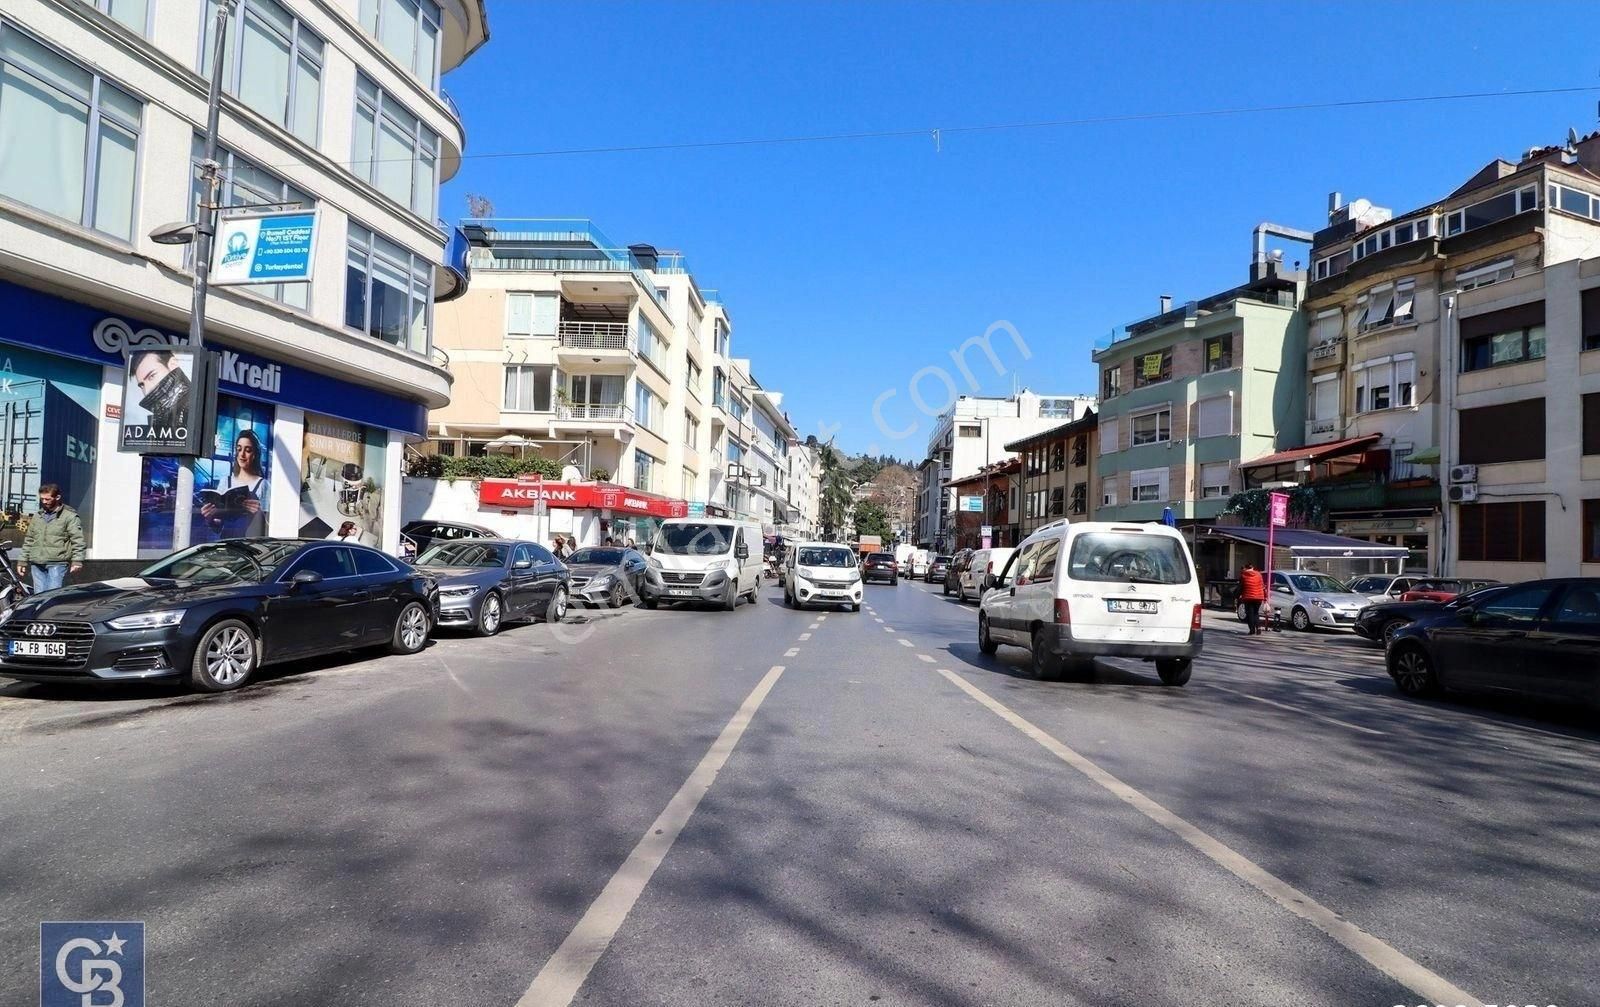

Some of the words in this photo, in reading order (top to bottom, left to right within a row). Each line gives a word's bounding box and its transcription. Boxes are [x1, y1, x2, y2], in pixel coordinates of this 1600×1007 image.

[265, 262, 303, 270] Turkeydental
[124, 426, 187, 439] ADAMO
[335, 442, 352, 454] YOK
[501, 488, 576, 501] AKBANK
[624, 498, 648, 510] AKBANK
[1113, 601, 1121, 609] 34
[14, 642, 24, 653] 34
[29, 642, 40, 654] FB
[44, 643, 64, 655] 1646
